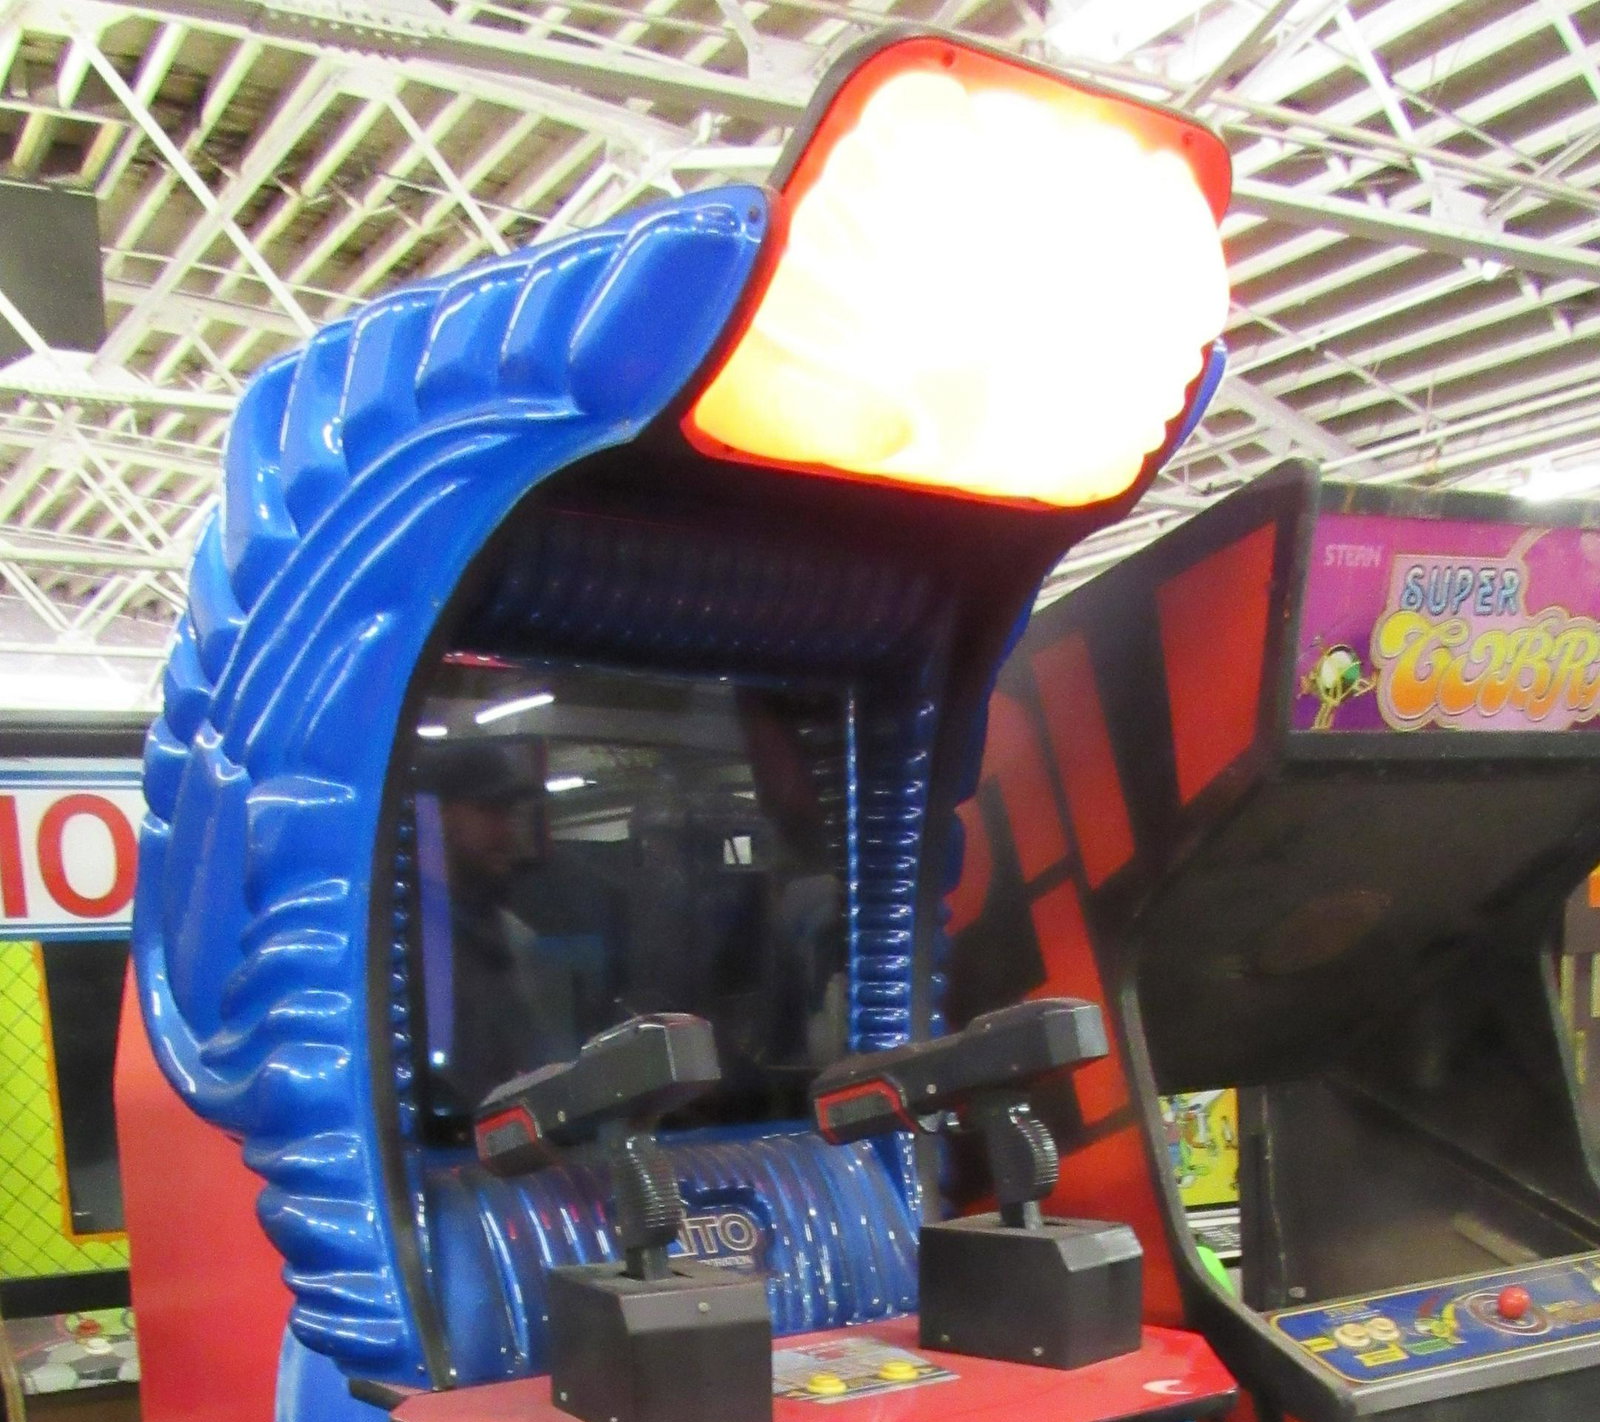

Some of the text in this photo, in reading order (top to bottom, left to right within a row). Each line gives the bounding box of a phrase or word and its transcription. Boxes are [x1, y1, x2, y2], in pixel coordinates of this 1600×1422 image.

[1323, 544, 1384, 568] STERN
[1400, 563, 1521, 617] SUPER
[1379, 609, 1600, 722] COBR
